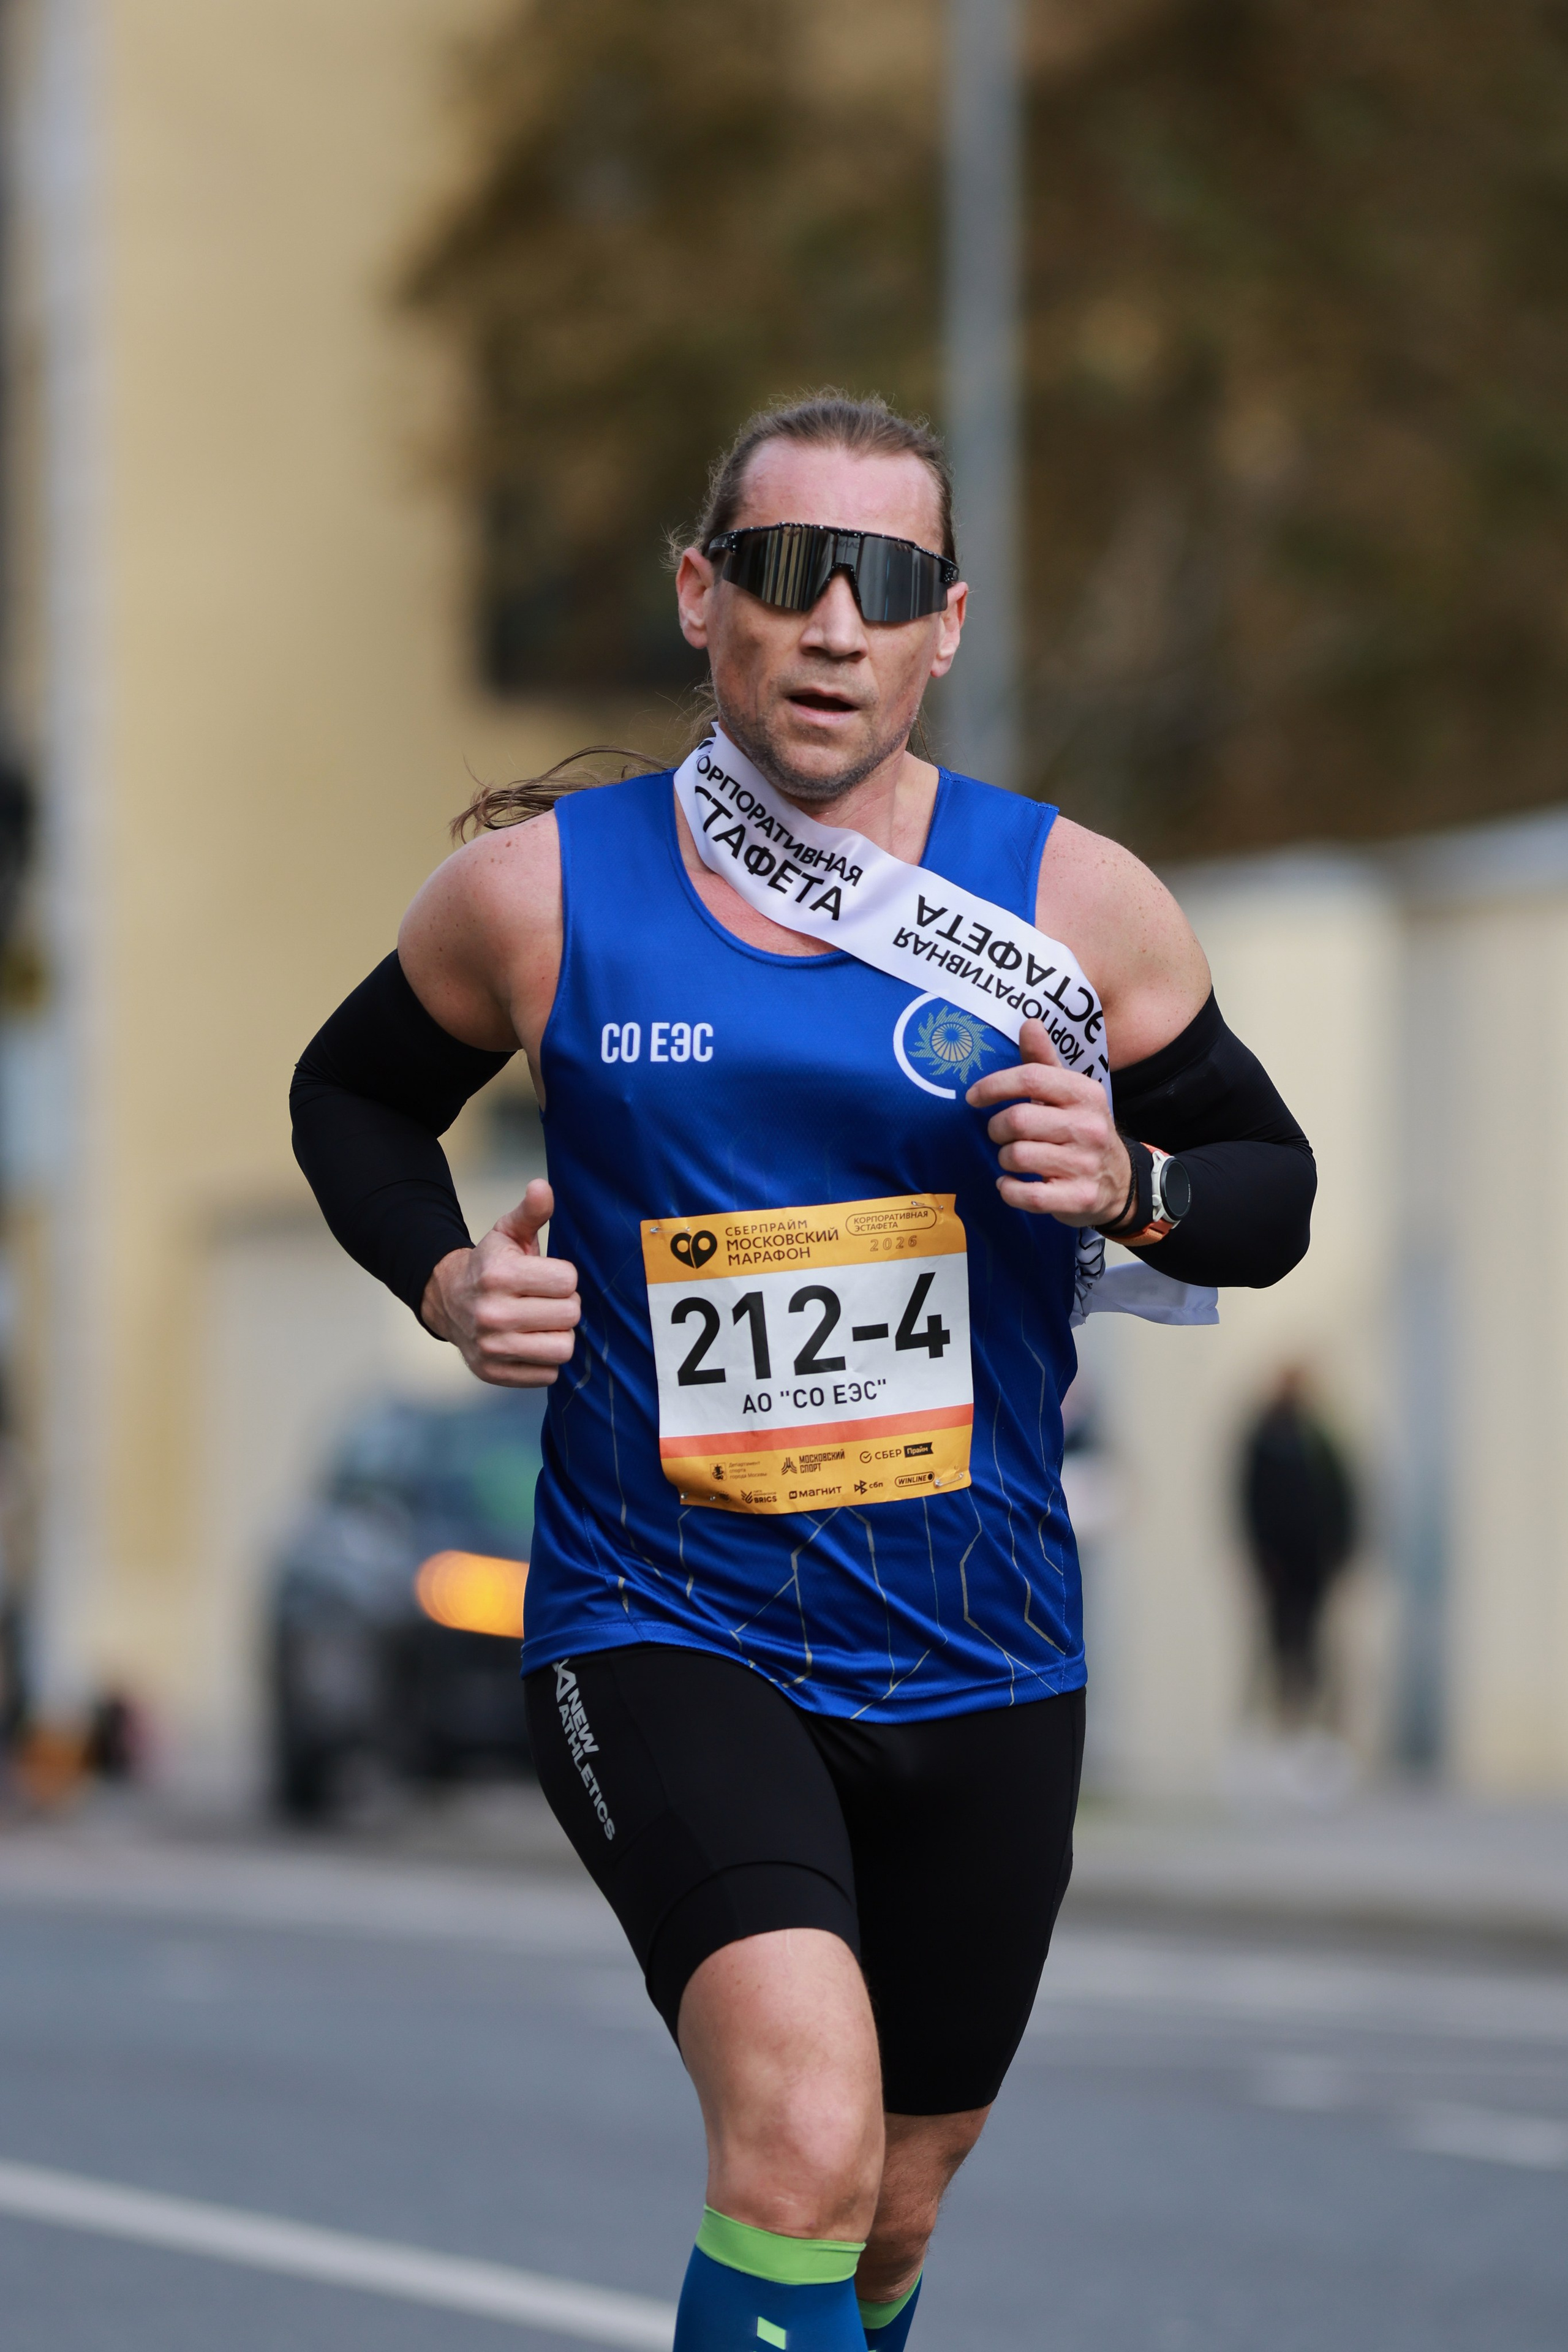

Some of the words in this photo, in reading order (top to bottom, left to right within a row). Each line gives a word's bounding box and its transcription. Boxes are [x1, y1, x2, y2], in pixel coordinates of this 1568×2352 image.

[696, 755, 864, 887] ОРПОРАТИВНАЯ
[916, 894, 1104, 1044] ЭСТАФЕТА
[601, 1022, 641, 1063] СО
[650, 1022, 714, 1062] ЕЭС
[854, 1210, 928, 1224] КОРПОРАТИВНАЯ
[854, 1221, 898, 1232] ЭСТАФЕТА
[725, 1219, 807, 1236] СБЕРПРАЙМ
[726, 1227, 839, 1251] МОСКОВСКИЙ
[870, 1235, 917, 1251] 2026
[728, 1246, 810, 1265] МАРАФОН
[671, 1272, 951, 1386] 212-4
[742, 1393, 772, 1414] АО
[780, 1387, 824, 1408] "СО
[833, 1379, 886, 1404] ЕЭС"
[799, 1449, 845, 1464] МОСКОВСКИЙ
[875, 1449, 902, 1460] СБЕР
[907, 1446, 929, 1455] Прайм
[800, 1463, 821, 1474] СПОРТ
[898, 1475, 927, 1485] WINLINE
[567, 1687, 600, 1754] NEW
[559, 1704, 615, 1841] ATHLETICS
